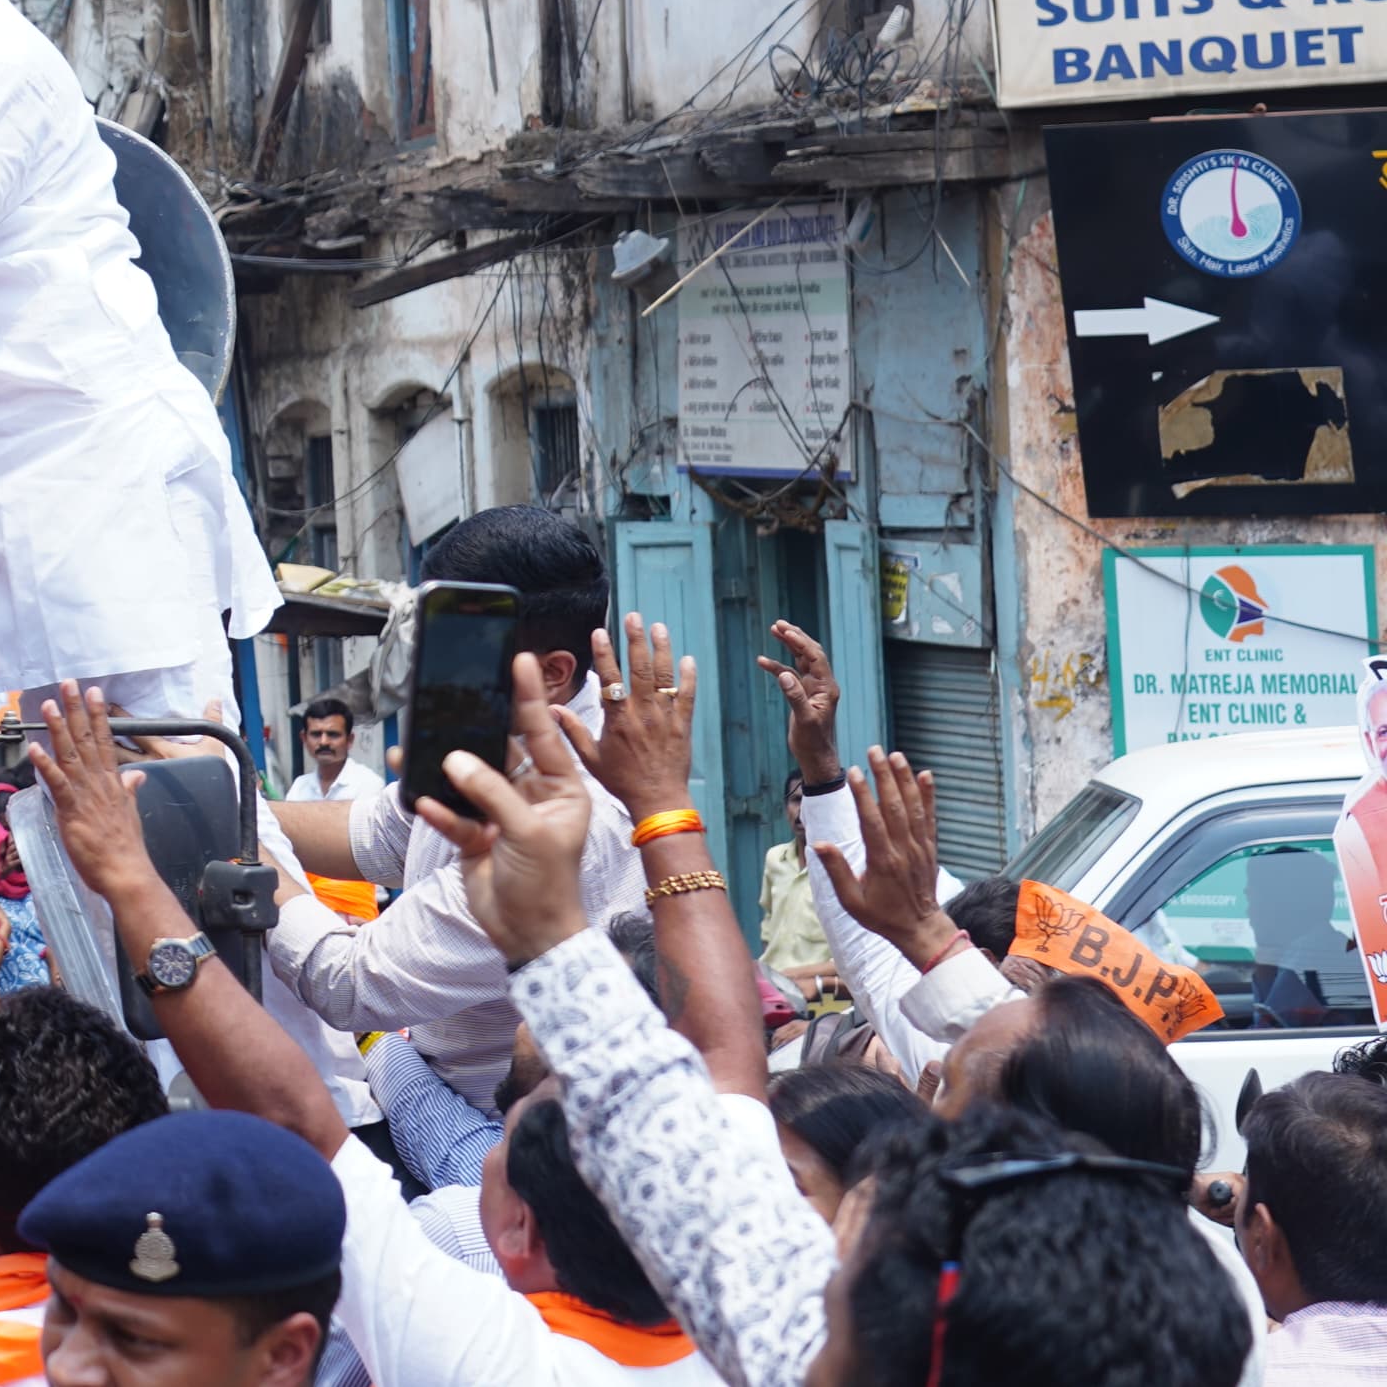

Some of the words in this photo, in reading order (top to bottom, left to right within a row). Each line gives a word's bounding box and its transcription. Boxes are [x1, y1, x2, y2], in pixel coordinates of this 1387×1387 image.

[1052, 24, 1364, 85] BANQUET
[1251, 161, 1288, 193] CLINIC
[1204, 648, 1231, 662] ENT
[1236, 648, 1284, 662] CLINIC
[1133, 674, 1164, 695] DR.
[1171, 673, 1255, 696] MATREJA
[1261, 673, 1358, 696] MEMORIAL
[1188, 702, 1221, 724] ENT
[1228, 702, 1287, 724] CLINIC
[1293, 702, 1307, 724] &
